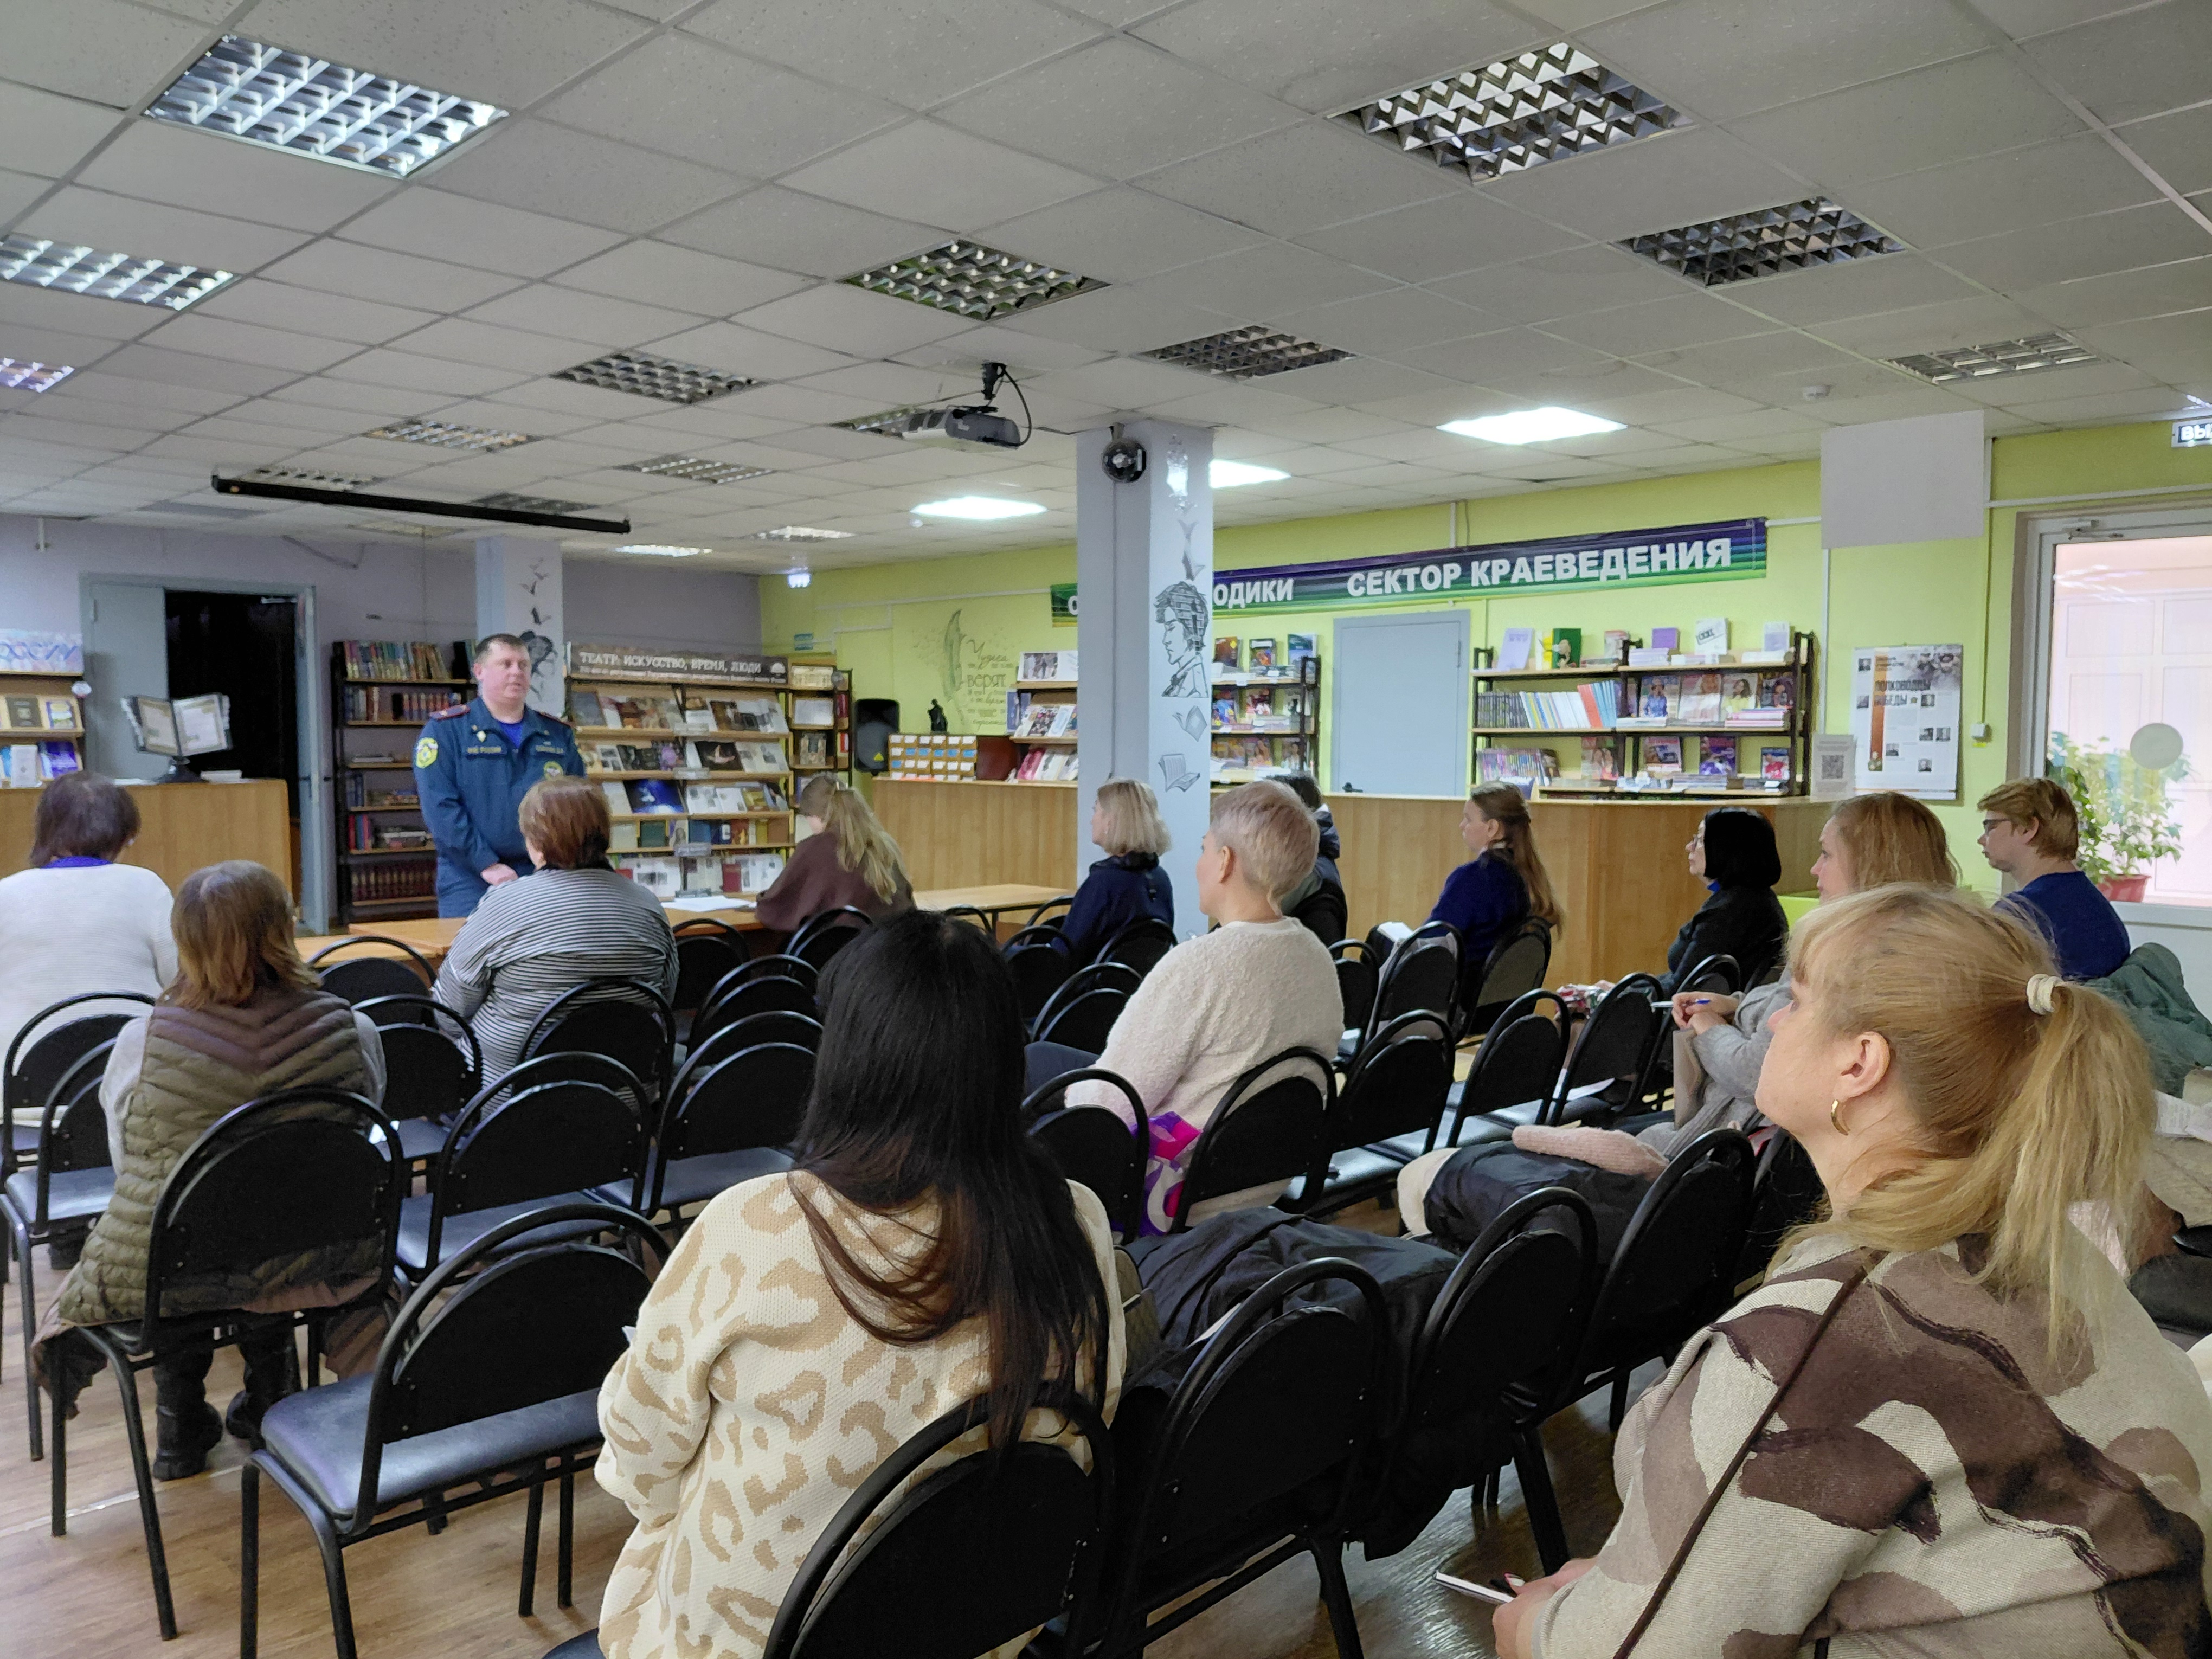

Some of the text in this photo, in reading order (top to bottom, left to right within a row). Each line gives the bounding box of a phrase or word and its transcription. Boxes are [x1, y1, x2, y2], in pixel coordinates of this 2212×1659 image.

[2181, 424, 2212, 441] ВЫ
[1347, 537, 1732, 597] СЕКТОР КРАЕВЕДЕНИЯ
[1213, 578, 1294, 609] ОДИКИ
